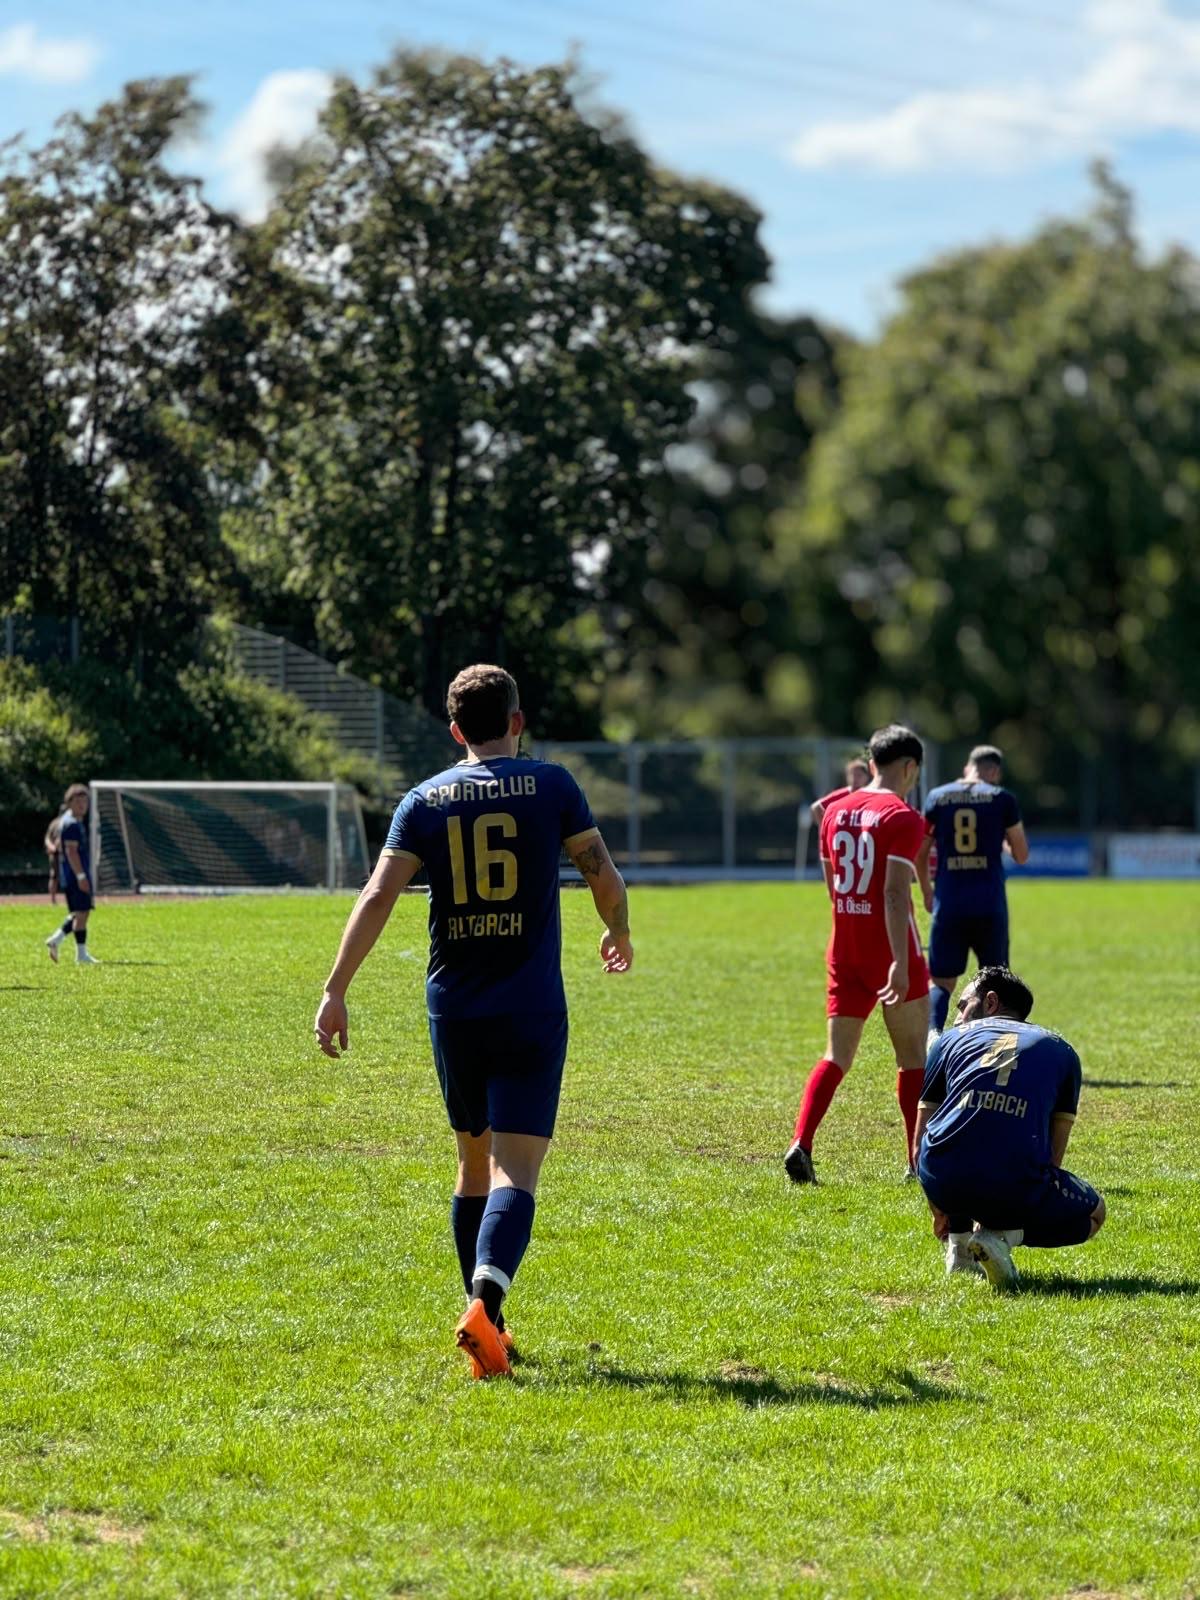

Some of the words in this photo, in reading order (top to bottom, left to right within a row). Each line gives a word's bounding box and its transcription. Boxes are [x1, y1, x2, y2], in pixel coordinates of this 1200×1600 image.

[426, 775, 537, 808] SPORTCLUB
[954, 808, 977, 854] 8
[446, 812, 518, 905] 16
[832, 831, 876, 895] 39
[447, 912, 523, 940] ALTBACH
